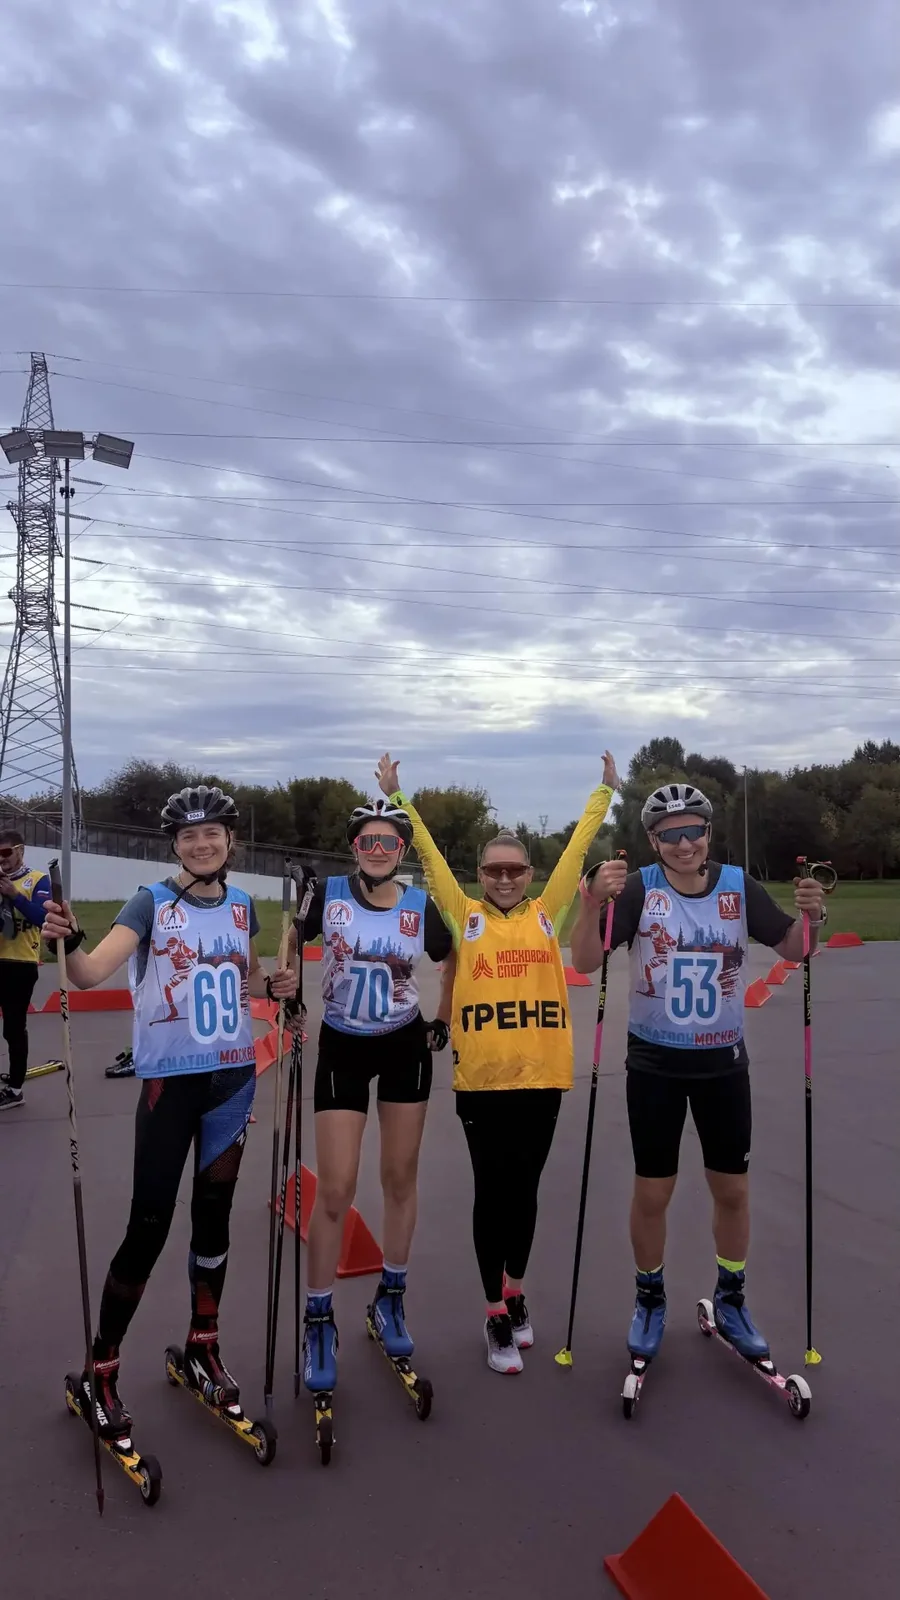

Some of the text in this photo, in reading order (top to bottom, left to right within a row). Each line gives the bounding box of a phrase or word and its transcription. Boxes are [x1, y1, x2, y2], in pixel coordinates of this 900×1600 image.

[349, 966, 389, 1022] 70
[497, 963, 529, 979] СПОРТ
[671, 958, 718, 1019] 53
[193, 968, 239, 1037] 69
